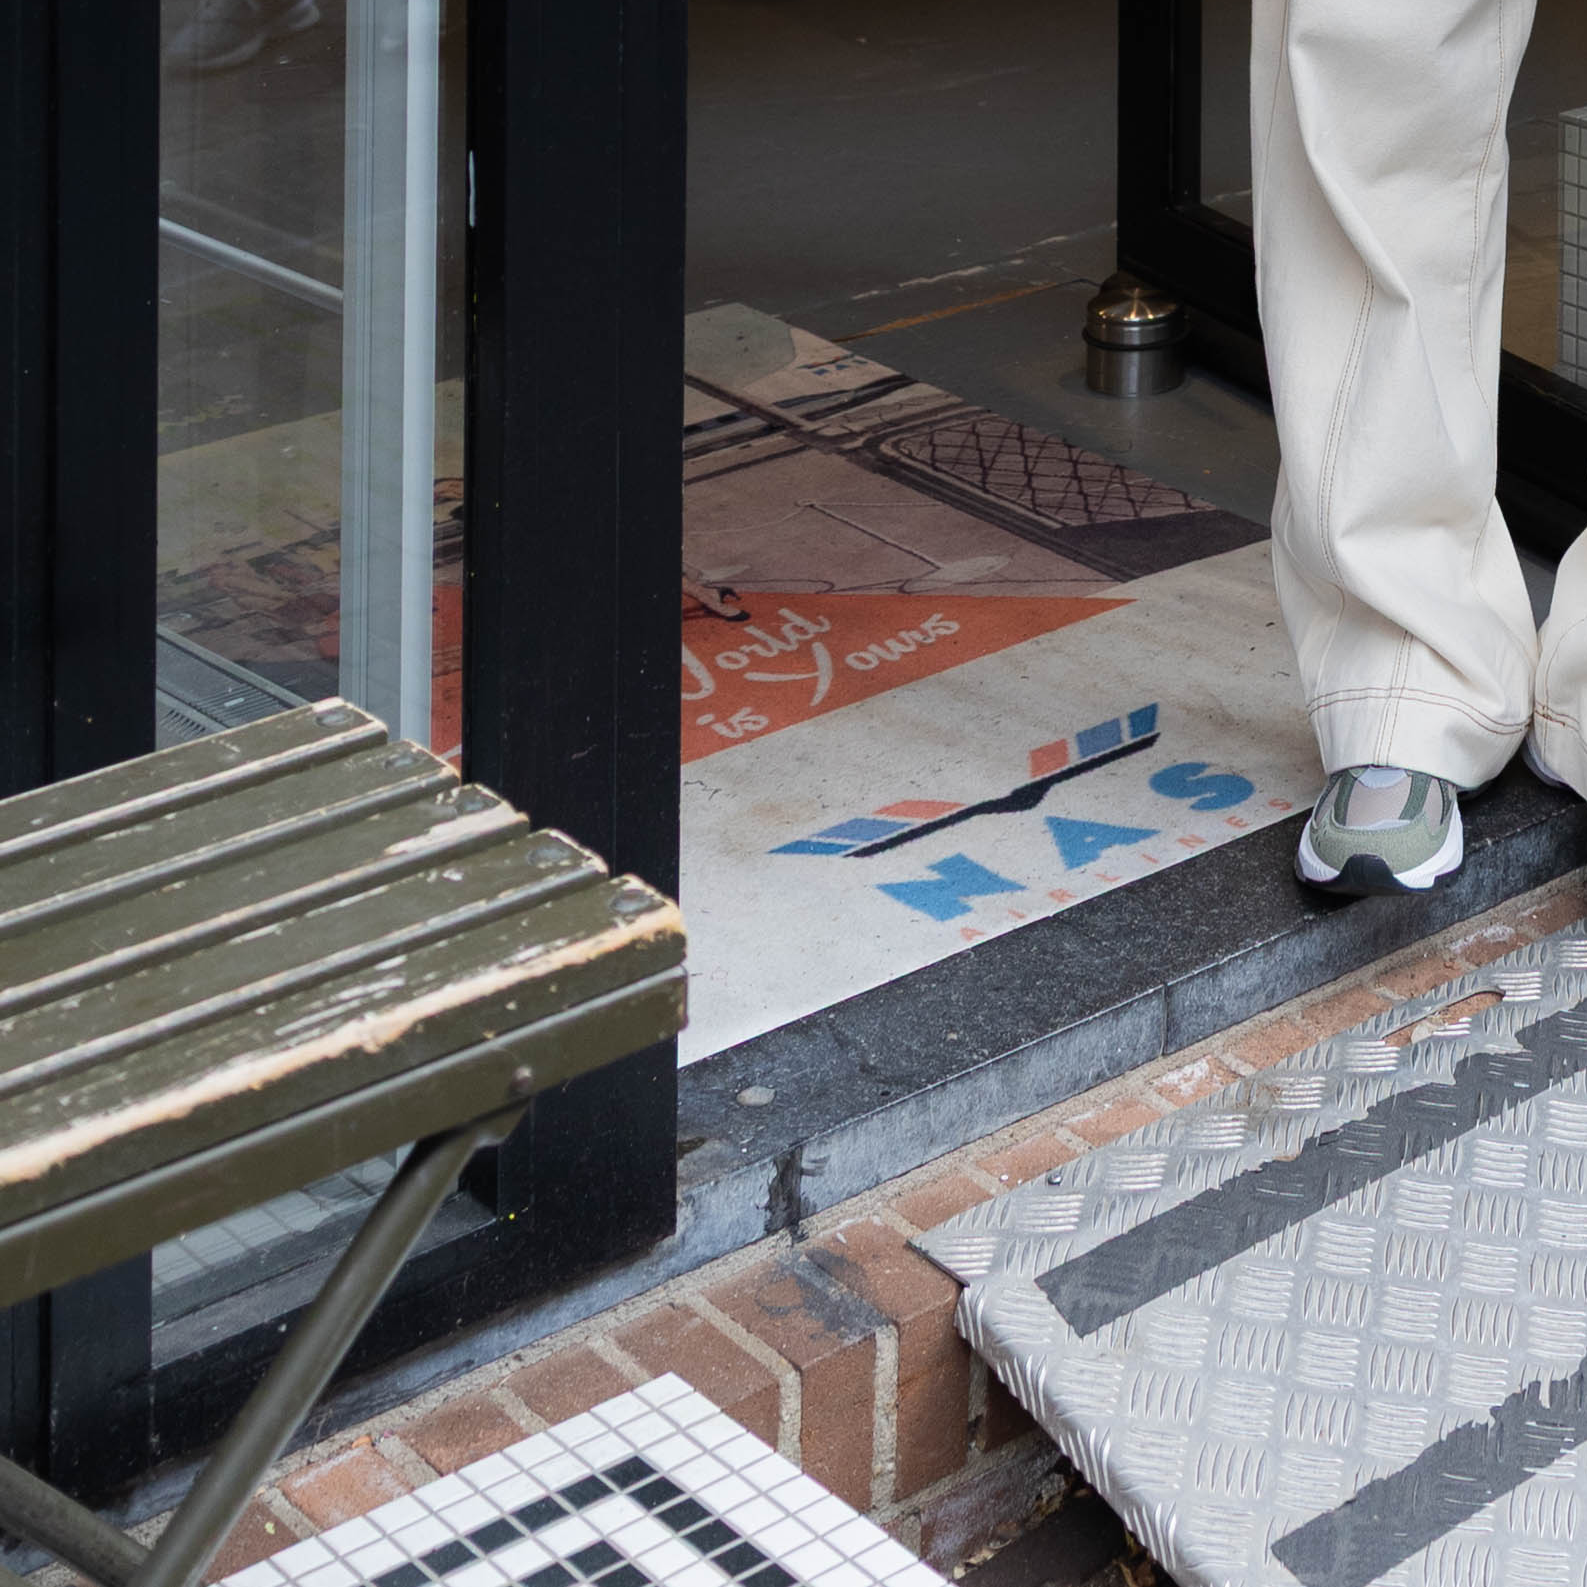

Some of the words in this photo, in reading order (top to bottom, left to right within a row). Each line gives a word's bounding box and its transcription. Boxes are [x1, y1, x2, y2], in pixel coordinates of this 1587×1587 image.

[696, 706, 769, 739] is
[744, 613, 960, 706] Yours
[876, 762, 1255, 922] NAS
[959, 797, 1293, 942] AIRLINES
